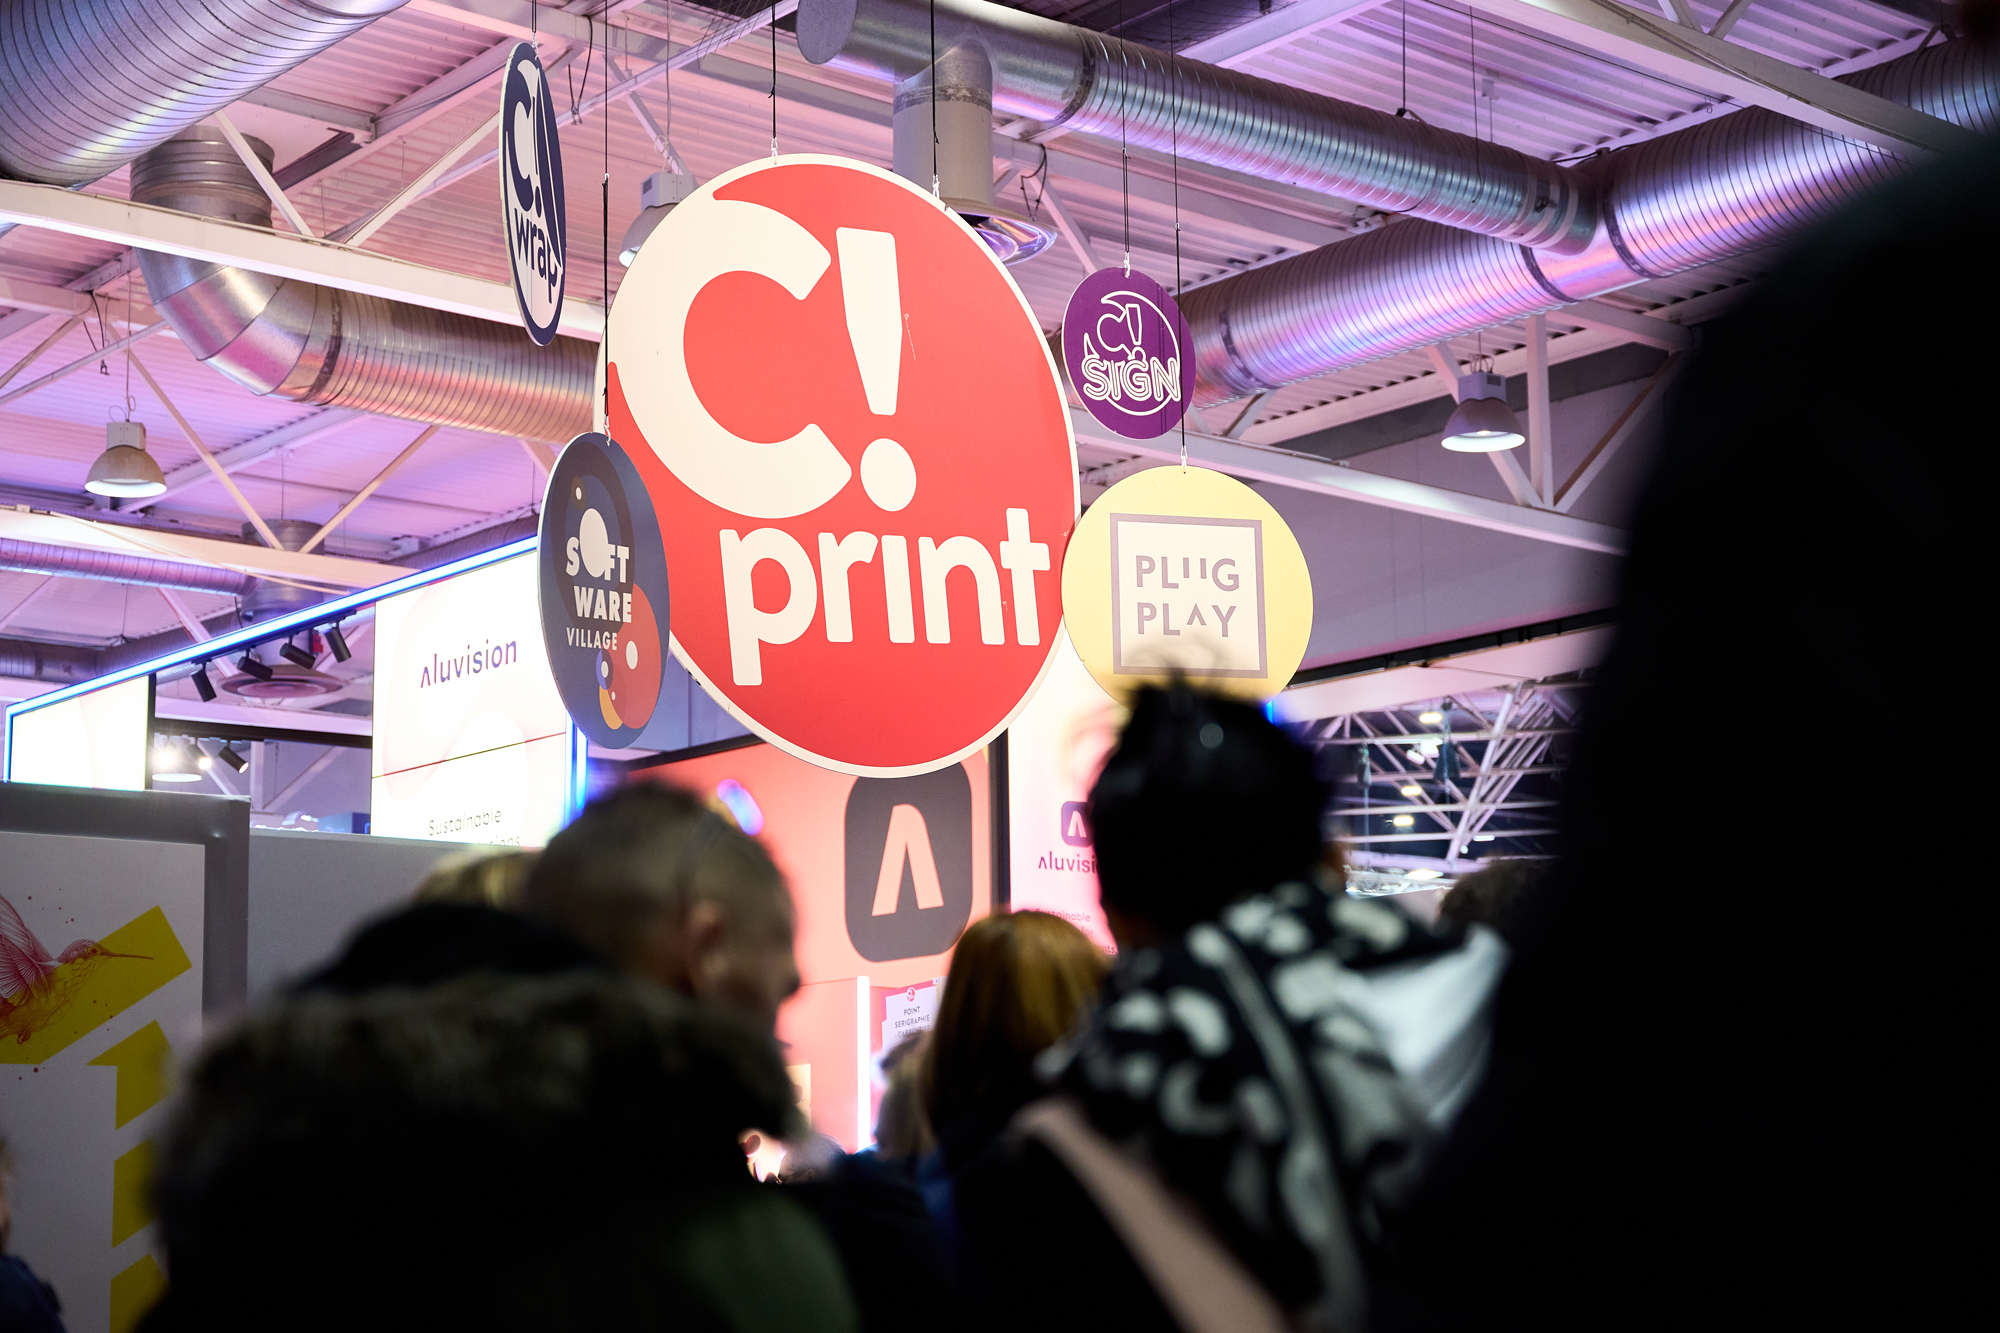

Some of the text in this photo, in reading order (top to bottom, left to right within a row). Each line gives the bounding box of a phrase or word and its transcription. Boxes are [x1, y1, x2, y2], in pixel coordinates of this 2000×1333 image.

[513, 206, 558, 304] wrap
[597, 198, 917, 519] C!
[1081, 354, 1181, 402] SIGN
[565, 508, 630, 583] SOFT
[573, 585, 632, 623] WARE
[719, 507, 1051, 686] print
[1136, 601, 1237, 638] PLAY
[565, 627, 618, 651] VILLAGE
[428, 807, 502, 837] Sustainable
[1035, 908, 1091, 923] ainable
[894, 1014, 930, 1028] SERIGRAPHIE
[903, 1006, 920, 1016] POINT
